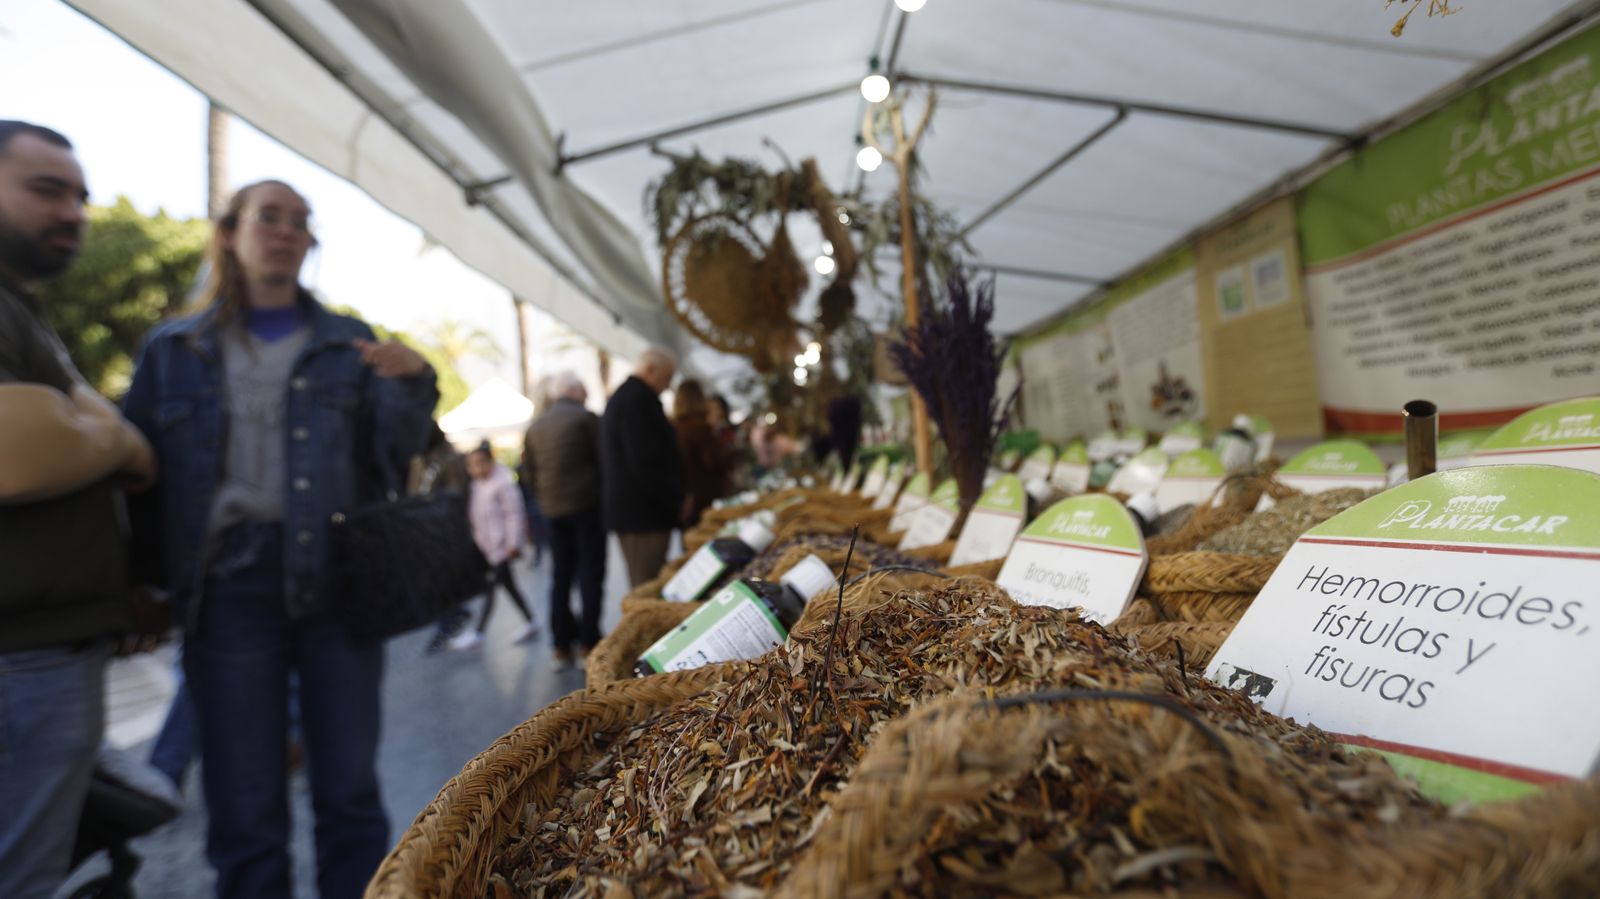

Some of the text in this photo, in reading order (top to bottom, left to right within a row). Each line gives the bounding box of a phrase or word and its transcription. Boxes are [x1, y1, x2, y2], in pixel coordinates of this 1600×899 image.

[1385, 156, 1524, 231] PLANTAS
[1377, 500, 1569, 534] PLANTACAR
[1296, 564, 1592, 636] Hemorroides,
[1312, 604, 1496, 675] fístulas y
[1304, 645, 1435, 709] fisuras
